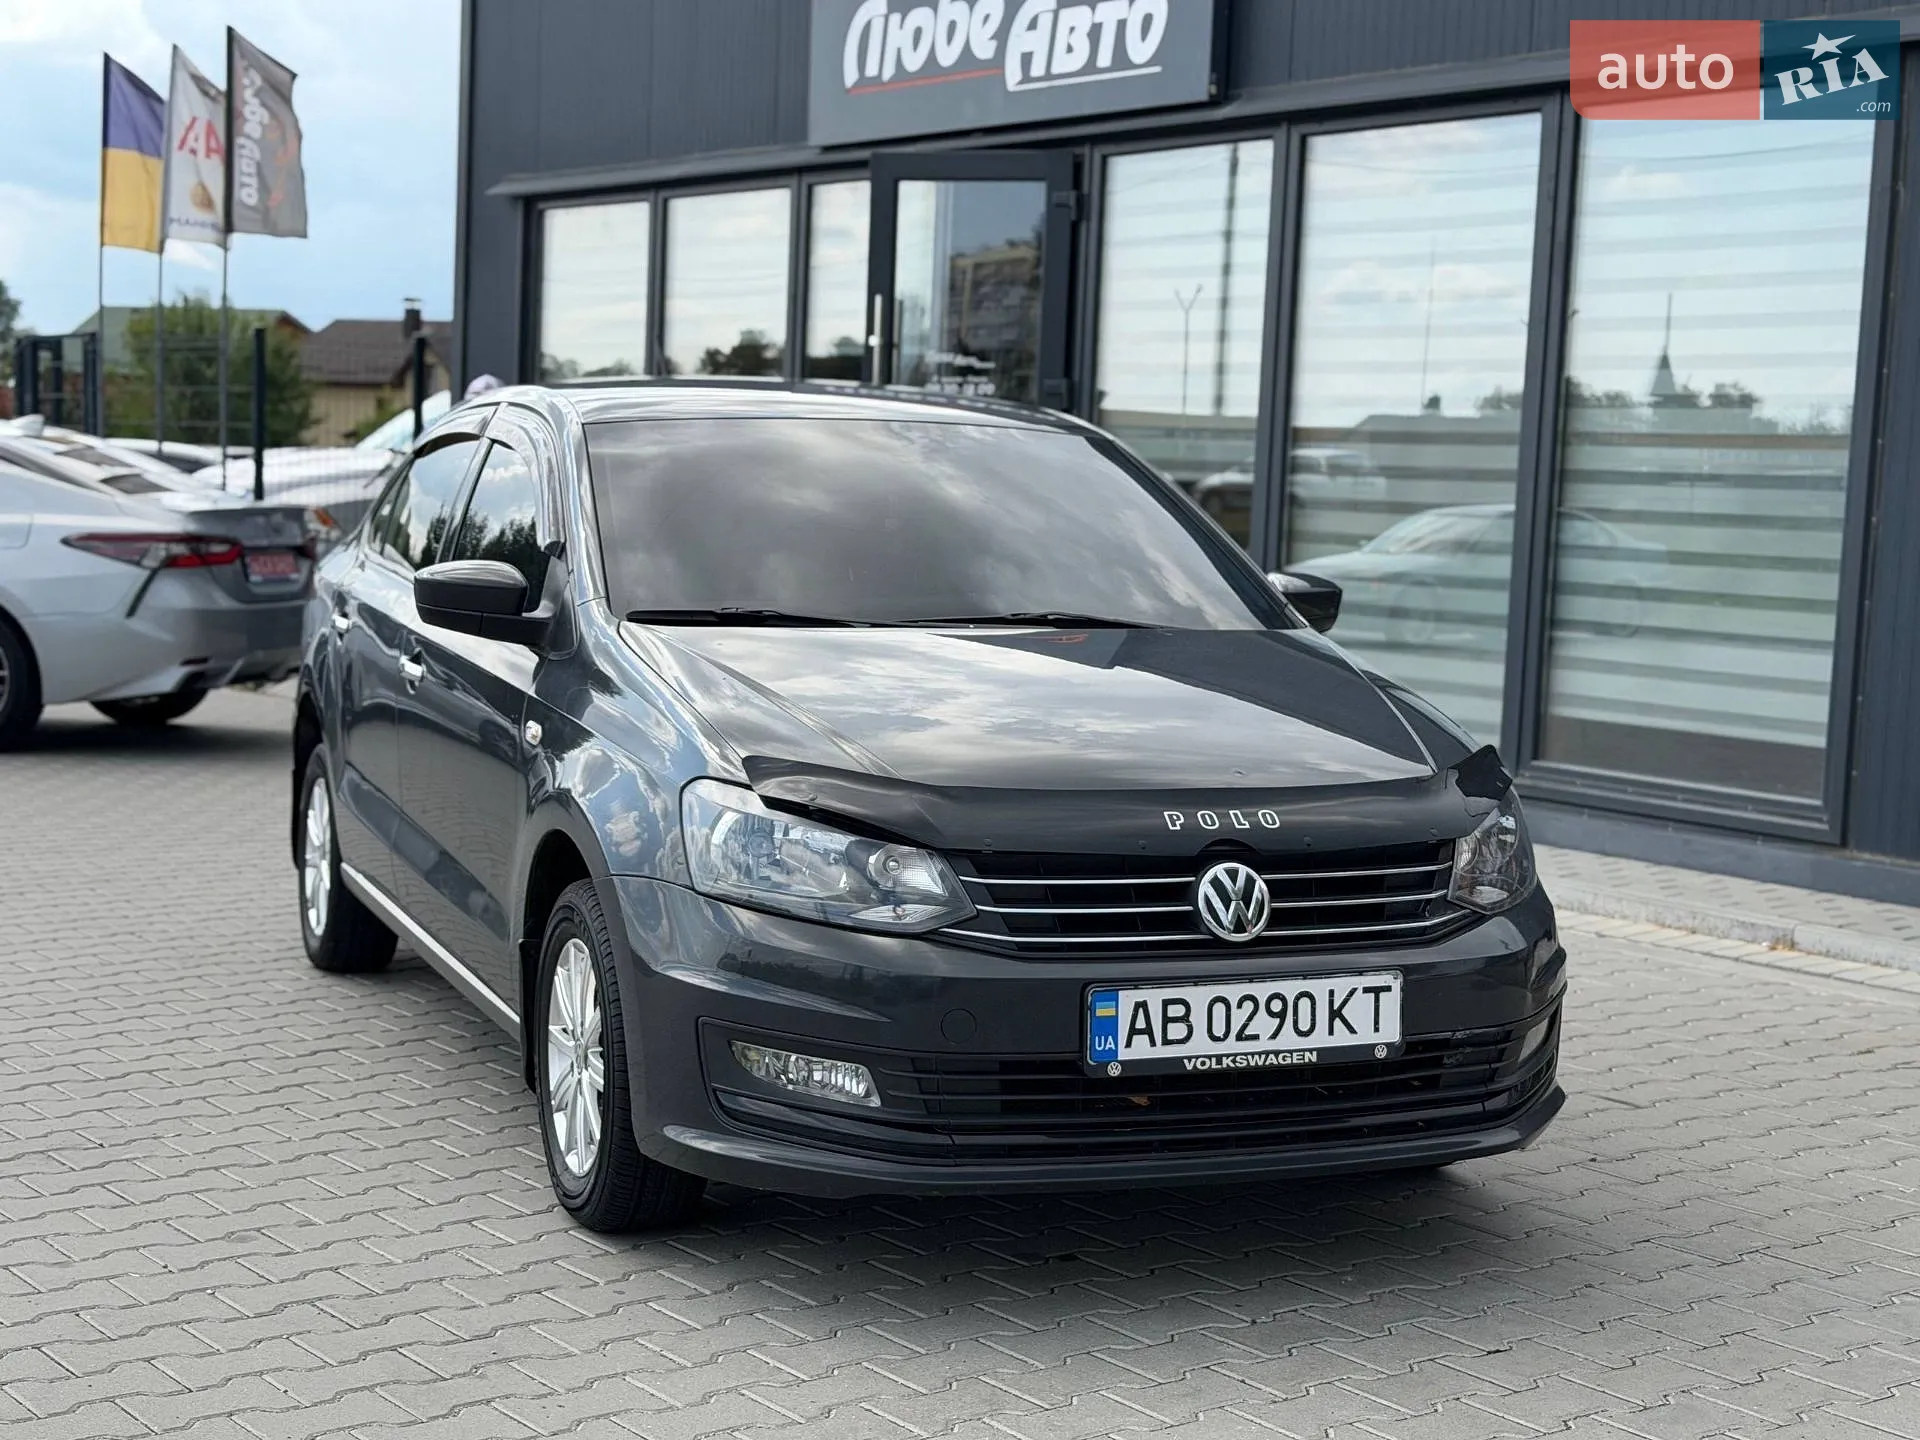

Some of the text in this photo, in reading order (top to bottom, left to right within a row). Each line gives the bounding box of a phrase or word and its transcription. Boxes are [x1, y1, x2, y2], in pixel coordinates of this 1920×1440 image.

[1163, 809, 1281, 830] POLO
[1124, 985, 1392, 1049] AB 0290 KT
[1094, 1034, 1116, 1052] UA
[1183, 1051, 1317, 1071] VOLKSWAGEN
